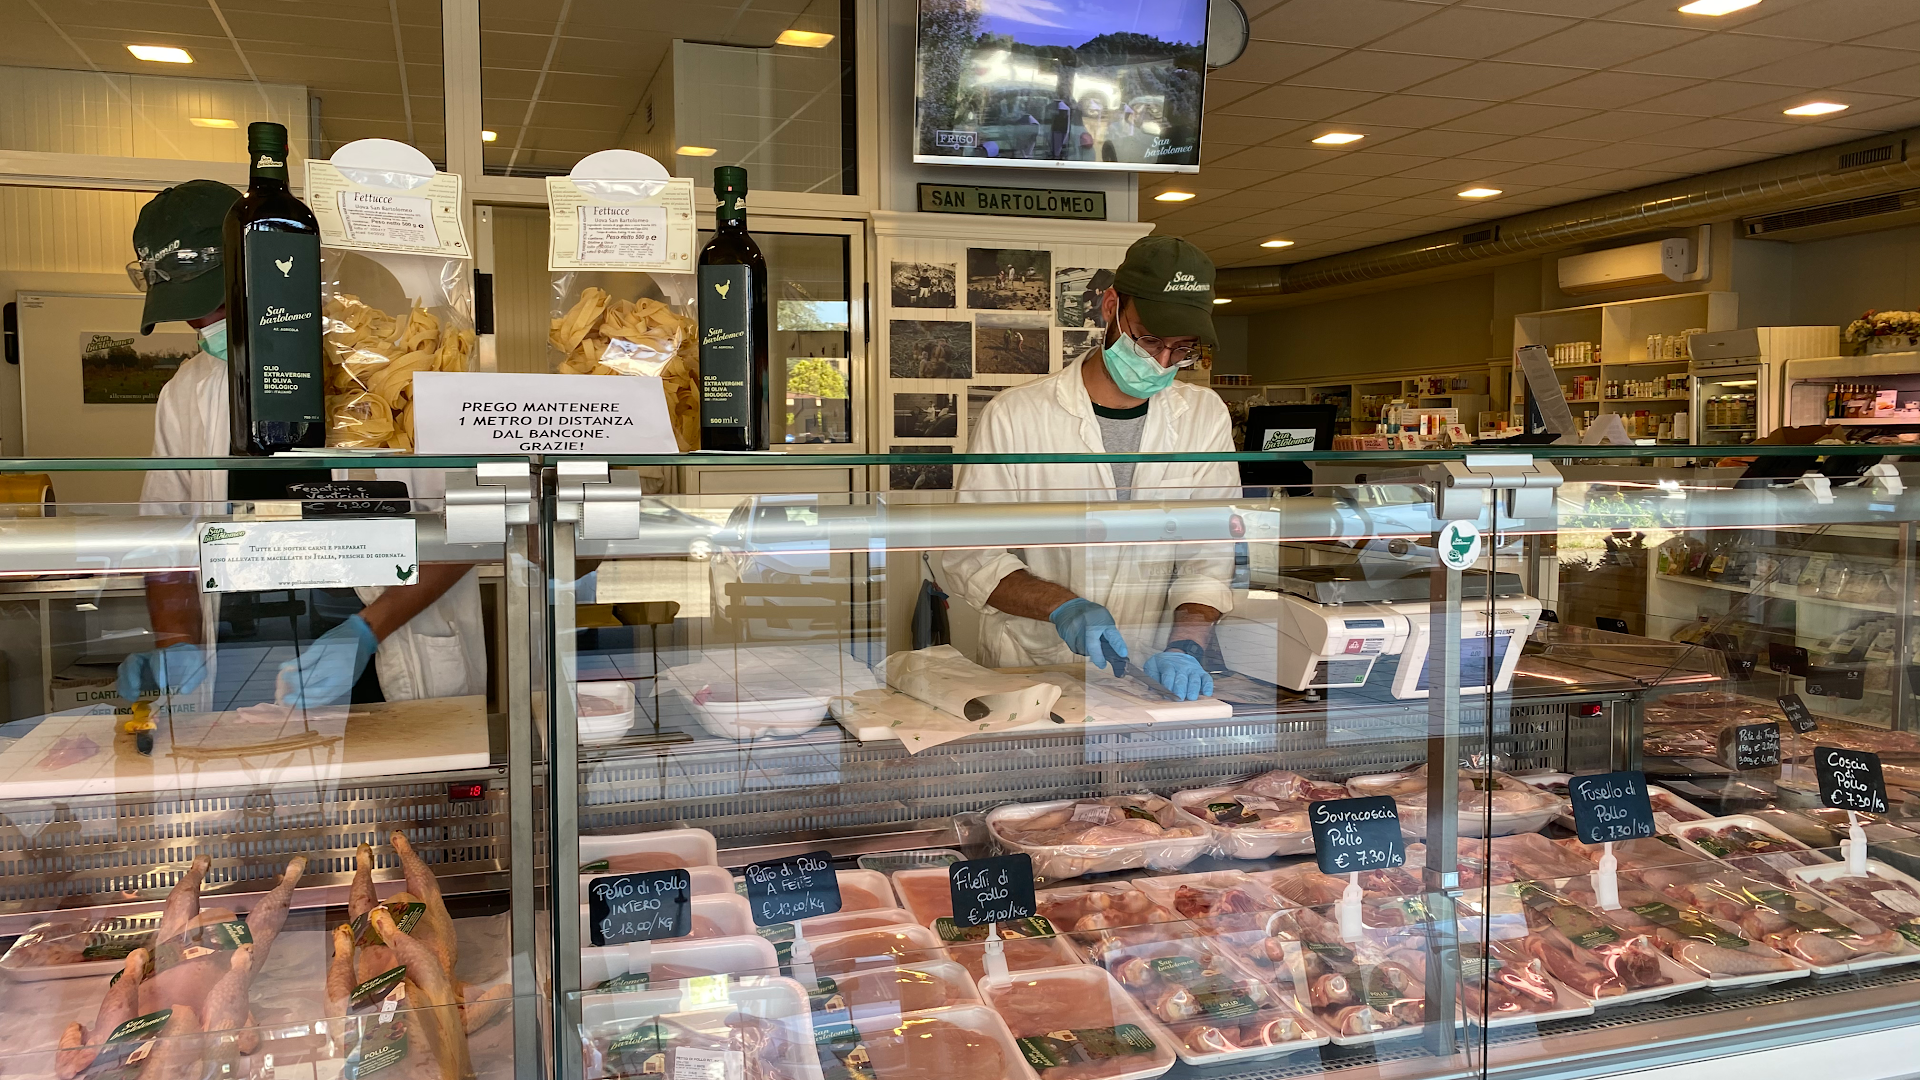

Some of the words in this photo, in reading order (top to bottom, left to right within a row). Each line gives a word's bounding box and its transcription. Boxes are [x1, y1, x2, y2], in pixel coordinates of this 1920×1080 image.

[940, 134, 974, 144] FRIGO
[1152, 137, 1170, 147] San
[1144, 144, 1193, 158] bartolomeo
[354, 191, 393, 204] Fettucce
[932, 190, 965, 207] SAN
[979, 192, 1094, 213] BARTOLOMEO
[593, 207, 630, 216] Fettucce
[1173, 271, 1195, 283] San
[266, 305, 285, 317] San
[259, 312, 312, 326] bartolomeo
[702, 330, 745, 345] bartolomeo
[708, 327, 723, 337] San
[86, 338, 135, 353] bartolomeo
[92, 335, 111, 344] San
[462, 402, 517, 412] PREGO
[522, 402, 620, 413] MANTENERE
[458, 416, 465, 426] 1
[472, 416, 533, 426] METRO
[538, 416, 553, 426] DI
[558, 416, 634, 426] DISTANZA
[722, 416, 733, 424] ml
[492, 429, 524, 439] DAL
[529, 429, 610, 439] BANCONE.
[1271, 431, 1291, 442] San
[519, 441, 584, 451] GRAZIE!
[1263, 436, 1314, 450] bartolomeo
[290, 484, 351, 494] Fegatini
[202, 531, 246, 543] bartolomeo
[208, 527, 225, 535] San
[1827, 752, 1869, 772] Coscia
[1845, 769, 1855, 779] di
[1834, 771, 1867, 792] Pollo
[470, 785, 481, 796] 18
[1578, 780, 1622, 801] Fusello
[1625, 779, 1636, 796] di
[1830, 789, 1843, 805] €
[1315, 805, 1397, 824] Sovracoscia
[1593, 804, 1628, 823] Pollo
[1345, 822, 1358, 833] di
[1591, 826, 1604, 841] €
[1327, 828, 1363, 847] Pollo
[1334, 853, 1350, 869] €
[746, 864, 777, 884] Petto
[780, 862, 793, 876] di
[796, 858, 828, 876] Pollo
[953, 866, 989, 891] Filetti
[998, 869, 1009, 886] di
[592, 878, 634, 901] Petto
[637, 879, 650, 894] di
[653, 876, 688, 896] pollo
[767, 882, 778, 896] A
[977, 887, 1009, 909] pollo
[612, 899, 661, 916] INTERO
[762, 901, 776, 919] €
[967, 908, 982, 925] €
[600, 918, 616, 940] €
[1157, 959, 1173, 967] San
[1157, 959, 1195, 972] bartolomeo
[1220, 1000, 1239, 1008] POLLO
[108, 1013, 170, 1041] bartolomeo
[125, 1018, 145, 1031] San
[364, 1046, 389, 1060] POLLO
